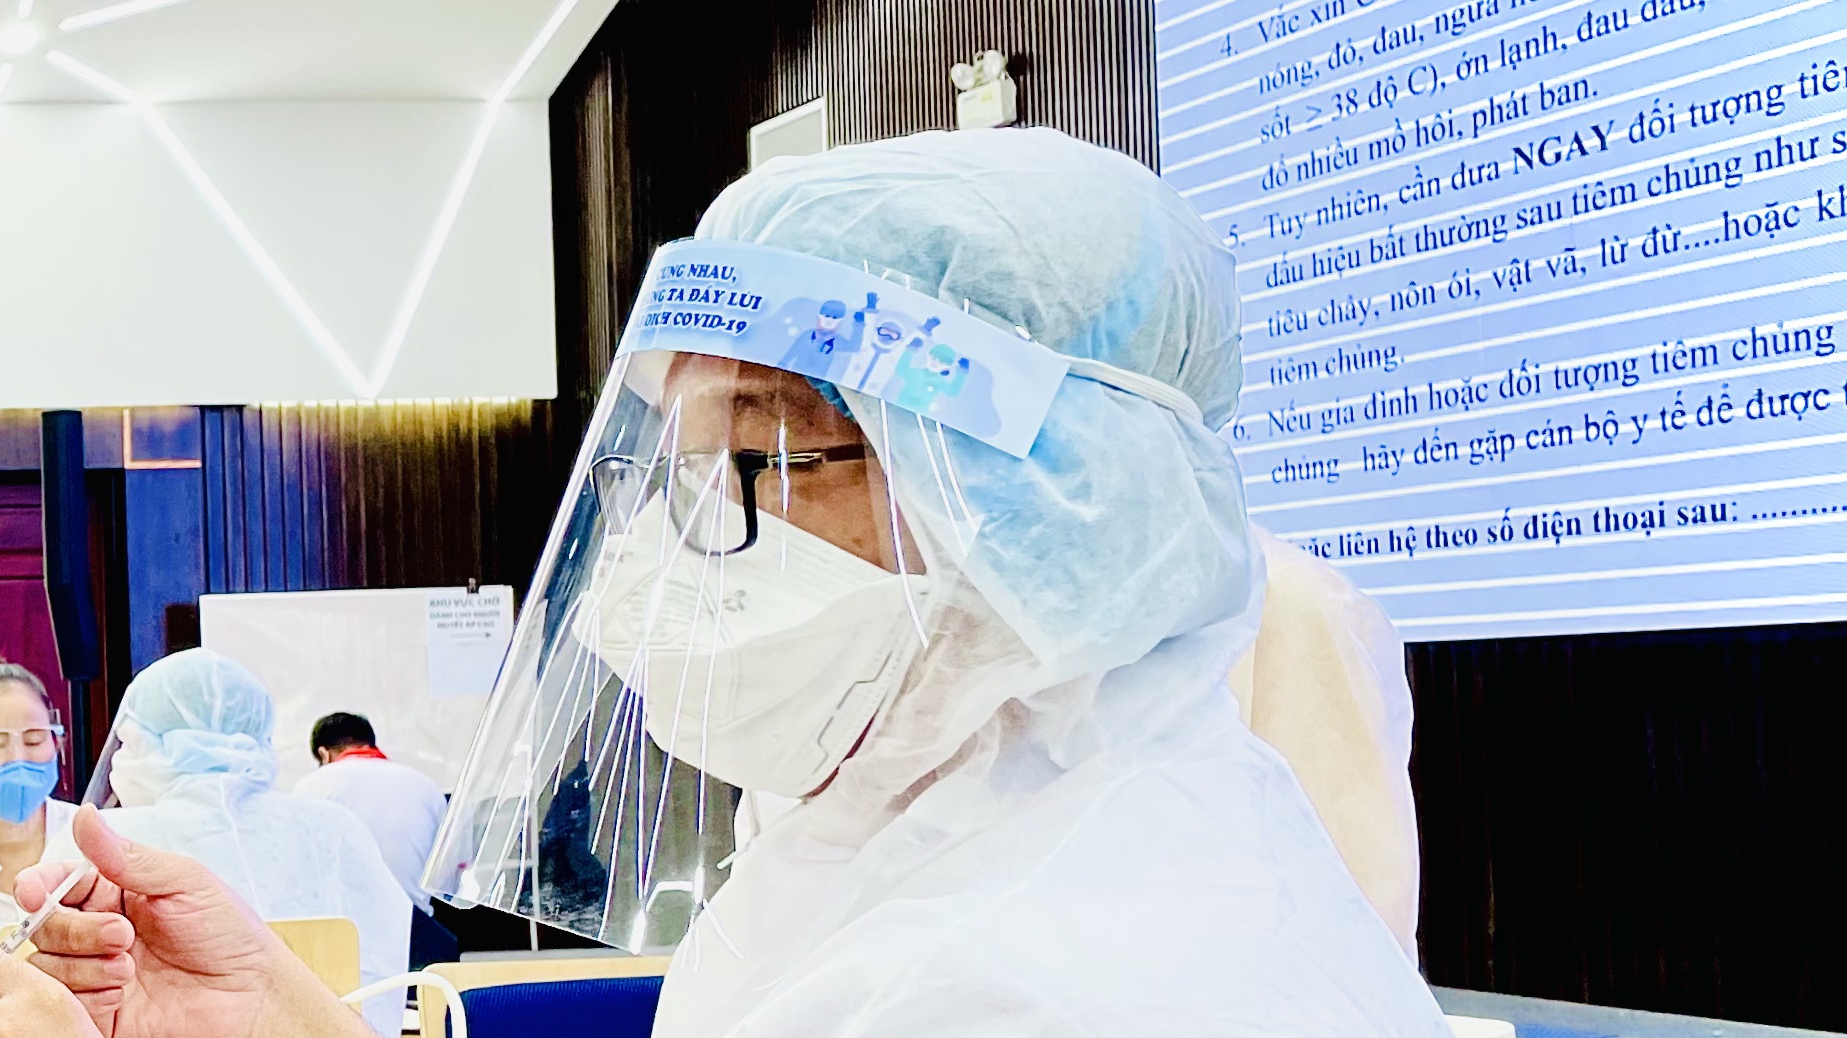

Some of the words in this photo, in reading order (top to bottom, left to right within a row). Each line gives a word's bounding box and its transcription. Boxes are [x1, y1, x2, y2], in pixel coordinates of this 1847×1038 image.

[1331, 88, 1359, 121] 38
[1500, 25, 1569, 71] lạnh,
[1576, 10, 1631, 43] đau
[1415, 108, 1464, 148] hôi,
[1473, 90, 1529, 138] phát
[1540, 78, 1599, 111] ban.
[1264, 211, 1308, 240] Tuy
[1317, 189, 1388, 226] nhiên,
[1512, 119, 1616, 175] NGAY
[1628, 98, 1676, 144] đối
[1690, 84, 1786, 127] tượng
[1798, 59, 1847, 99] tiê
[1415, 215, 1508, 253] thường
[1516, 200, 1564, 230] sau
[1572, 181, 1638, 216] tiêm
[1755, 136, 1820, 173] như
[687, 262, 737, 284] NHAU,
[1390, 281, 1436, 312] nôn
[1448, 267, 1481, 300] ói,
[1493, 258, 1533, 293] vật
[673, 312, 749, 335] COVID-19
[1269, 356, 1318, 386] tiêm
[1320, 397, 1355, 434] gia
[1428, 377, 1489, 412] hoặc
[1554, 356, 1640, 392] tượng
[1651, 339, 1719, 375] tiêm
[1362, 444, 1405, 476] hãy
[1469, 427, 1515, 466] gặp
[1525, 418, 1574, 451] cán
[1584, 409, 1620, 446] bộ
[1630, 412, 1649, 445] y
[1660, 390, 1688, 433] tế
[1746, 387, 1832, 422] được
[1339, 532, 1380, 558] liên
[1389, 526, 1418, 559] hệ
[1426, 524, 1479, 550] theo
[1487, 506, 1515, 544] số
[1593, 500, 1667, 537] thoại
[1677, 501, 1738, 528] sau:
